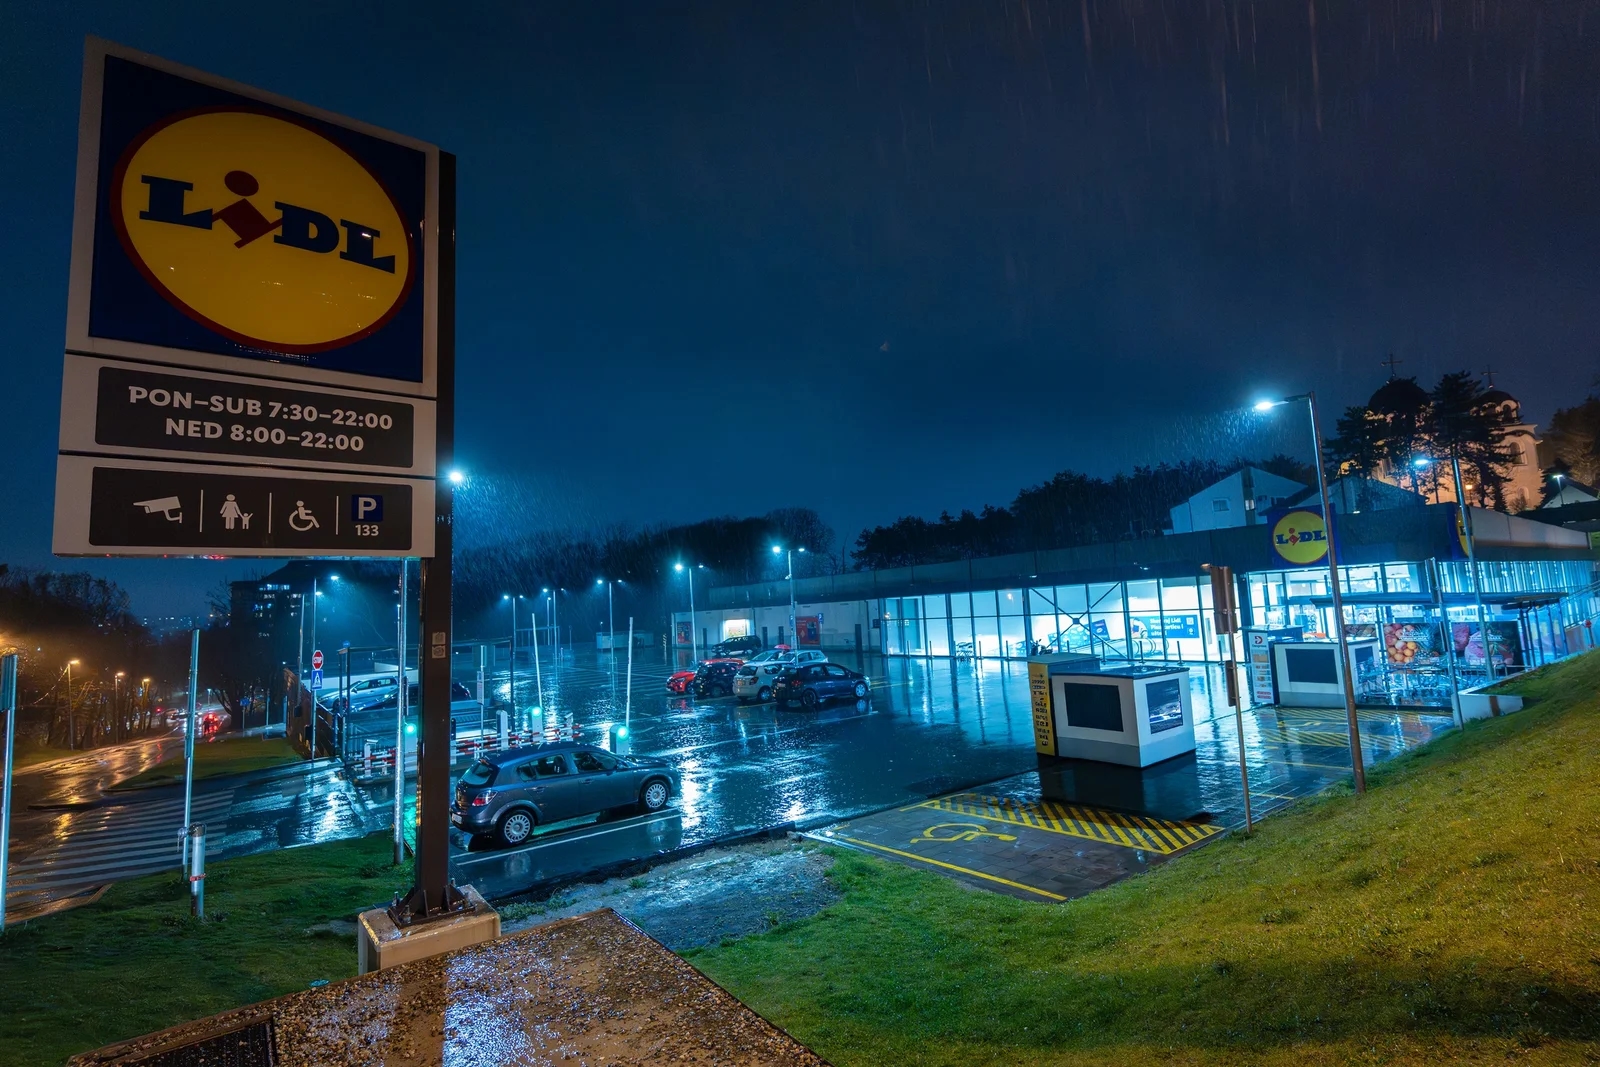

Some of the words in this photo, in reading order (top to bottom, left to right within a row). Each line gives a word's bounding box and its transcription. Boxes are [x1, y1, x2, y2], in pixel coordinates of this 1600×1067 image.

[165, 418, 223, 439] NED
[358, 497, 377, 520] P
[355, 524, 379, 537] 133
